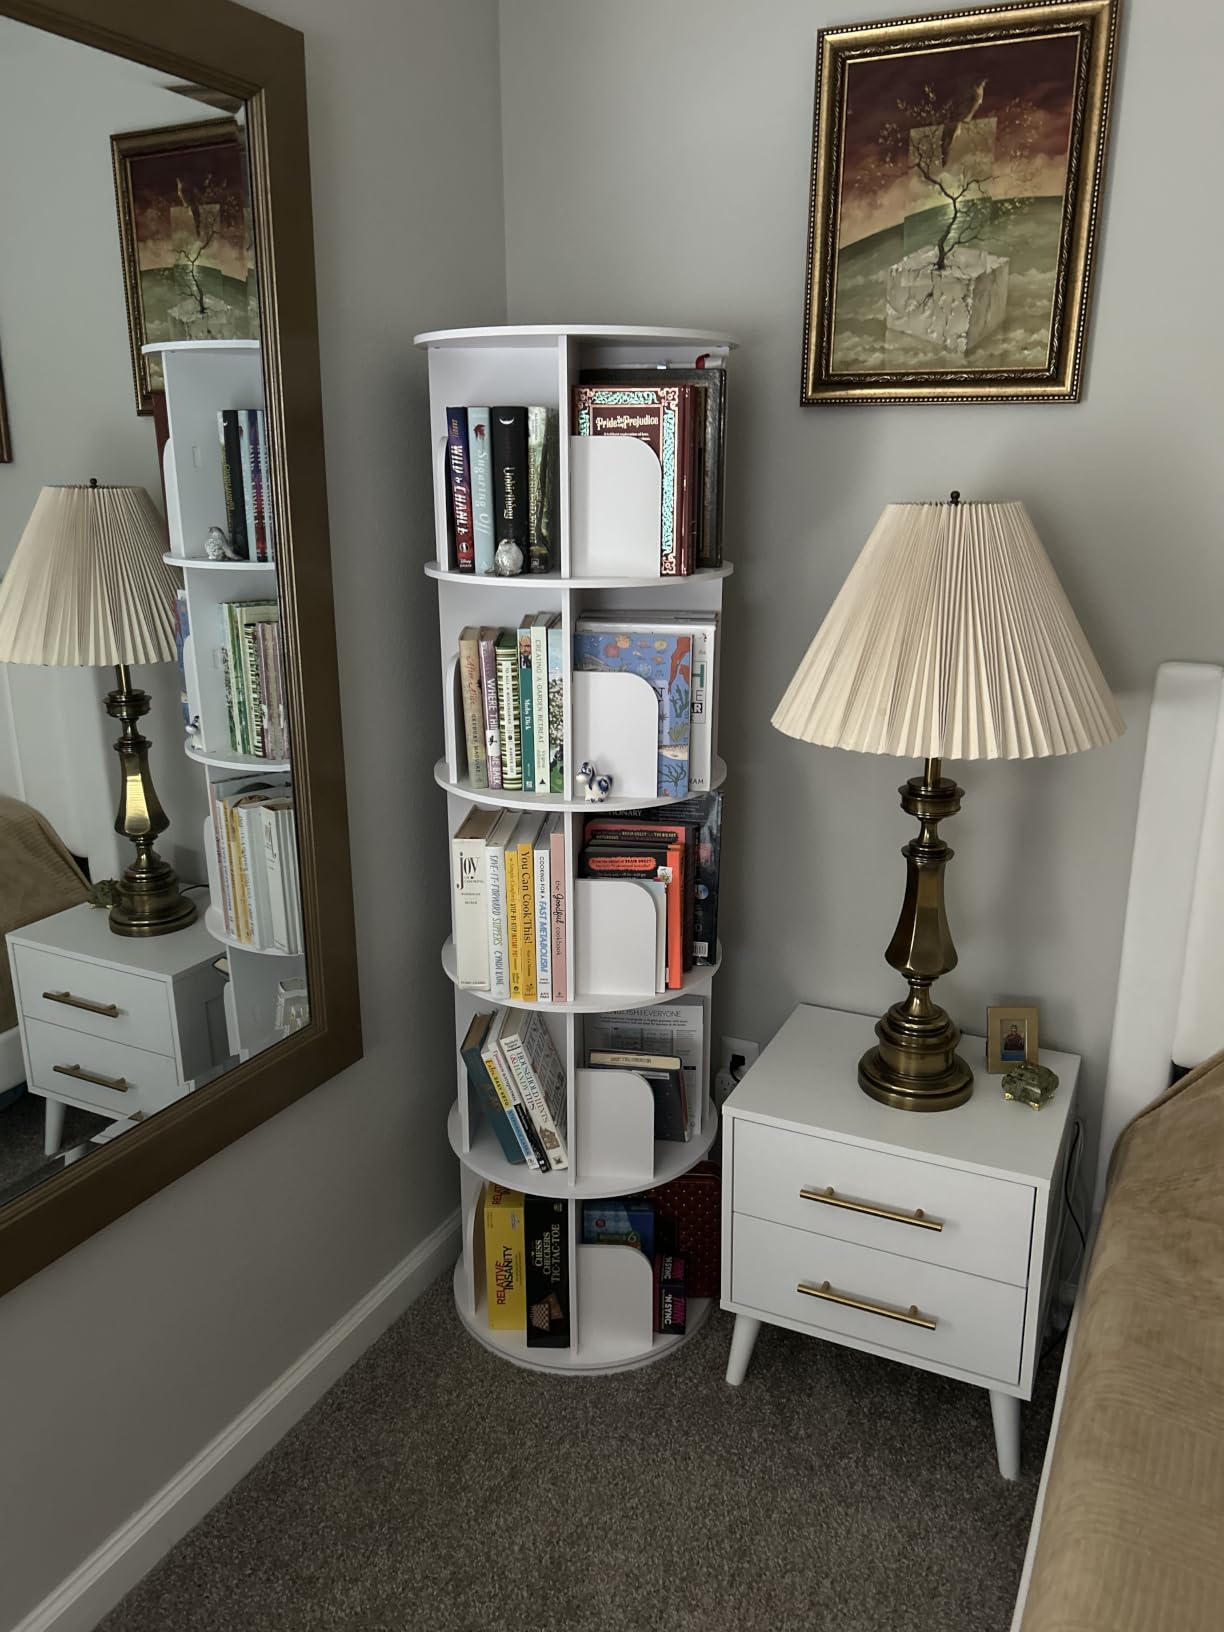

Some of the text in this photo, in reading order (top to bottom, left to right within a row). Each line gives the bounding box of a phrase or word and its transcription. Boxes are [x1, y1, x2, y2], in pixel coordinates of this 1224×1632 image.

[595, 417, 617, 431] Pride
[622, 414, 659, 430] Prejudice
[450, 444, 464, 475] WILD
[474, 450, 490, 535] Sugaring Off
[502, 466, 516, 520] Unbirthday
[454, 485, 470, 536] CHANCE
[534, 639, 542, 674] CREATING
[486, 678, 499, 712] WHERE
[523, 699, 532, 731] Moby Dick
[492, 766, 502, 785] BACK
[521, 850, 533, 945] You Can Cook This!
[538, 900, 548, 921] FAST
[492, 917, 503, 946] SUPPERS
[539, 921, 549, 973] METABOLISM
[555, 926, 563, 956] cookbook
[494, 949, 505, 986] CYNDI KANE
[643, 1010, 681, 1018] EVERYONE
[509, 1054, 518, 1065] &
[513, 1064, 529, 1092] HANDY
[517, 1051, 540, 1099] HOUSEHOLD
[532, 1097, 550, 1124] HINTS
[499, 1091, 509, 1106] KETO
[523, 1091, 537, 1111] TIPS
[535, 1239, 543, 1267] CHESS
[543, 1231, 551, 1275] CHECKERS
[495, 1260, 506, 1305] RELATIVE
[664, 1303, 673, 1325] SYNC
